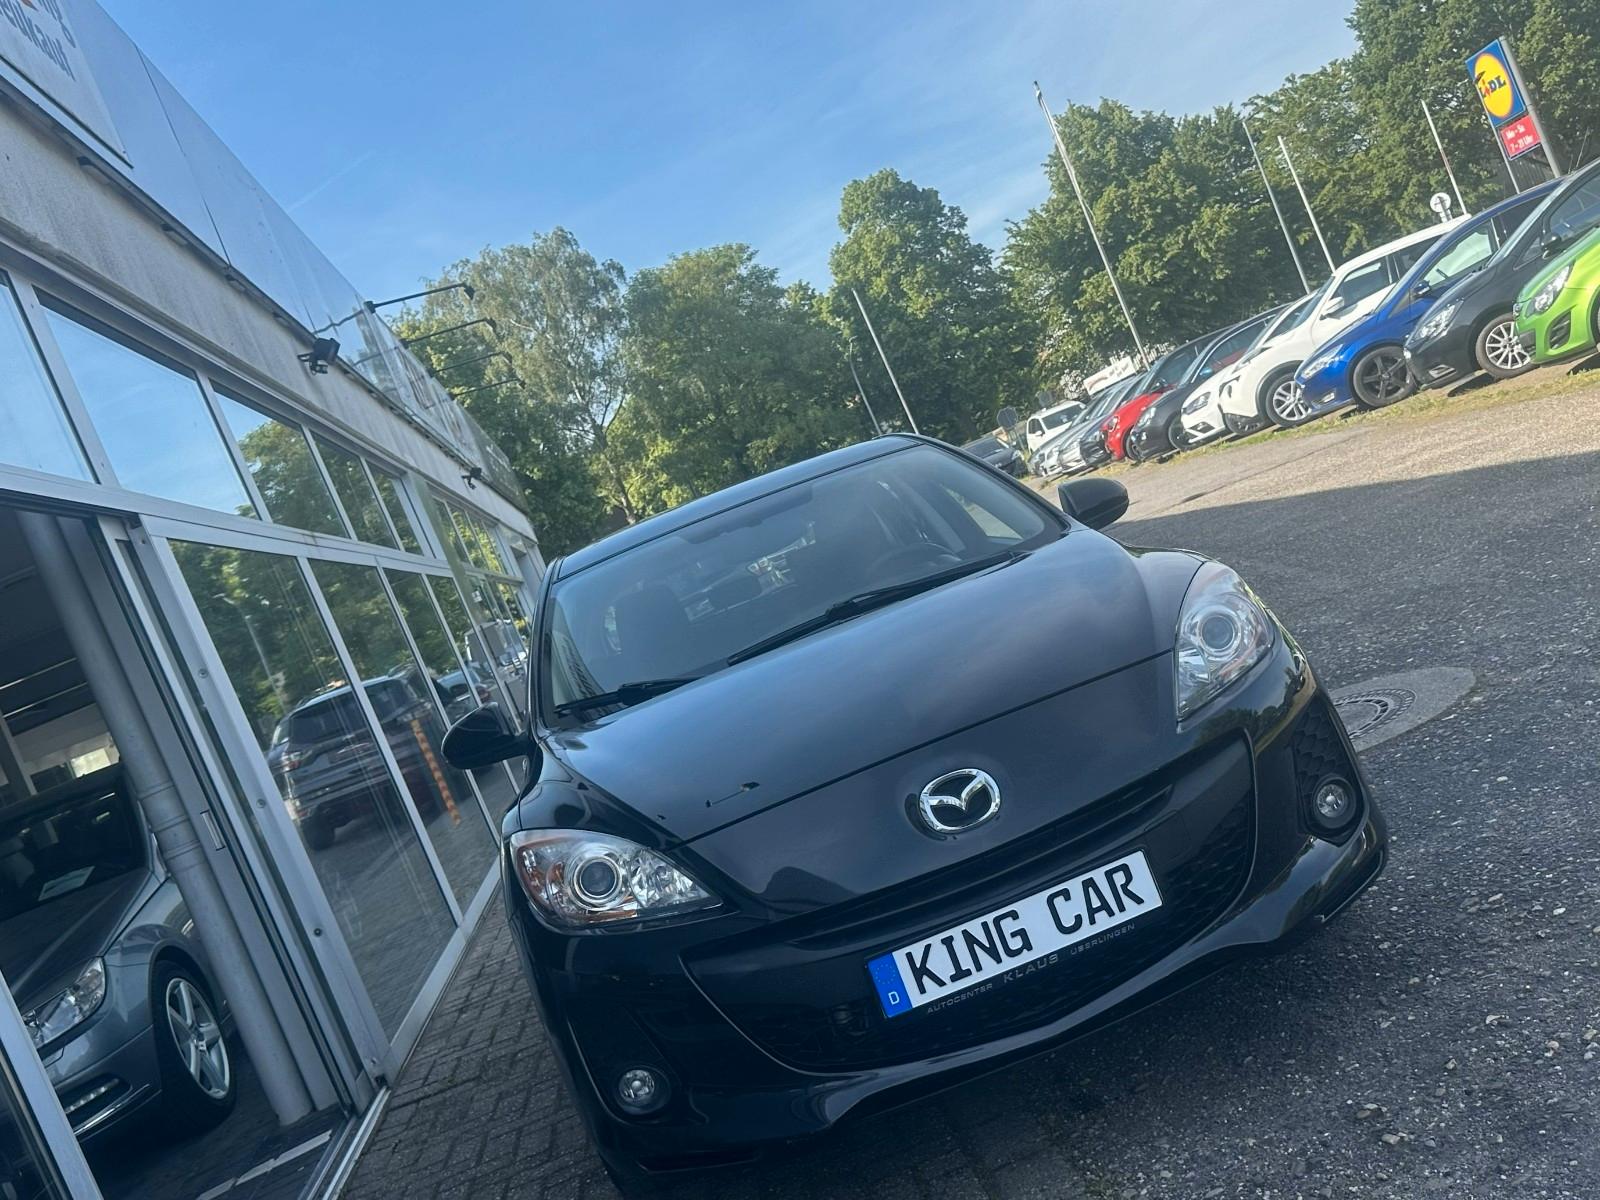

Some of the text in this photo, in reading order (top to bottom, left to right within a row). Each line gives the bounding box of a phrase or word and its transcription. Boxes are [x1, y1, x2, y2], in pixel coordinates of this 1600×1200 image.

[0, 0, 76, 81] eukauf
[905, 862, 1145, 995] KING CAR
[888, 991, 900, 1005] D
[926, 983, 993, 1014] AUTOCENTER
[1002, 954, 1059, 983] KLAUS
